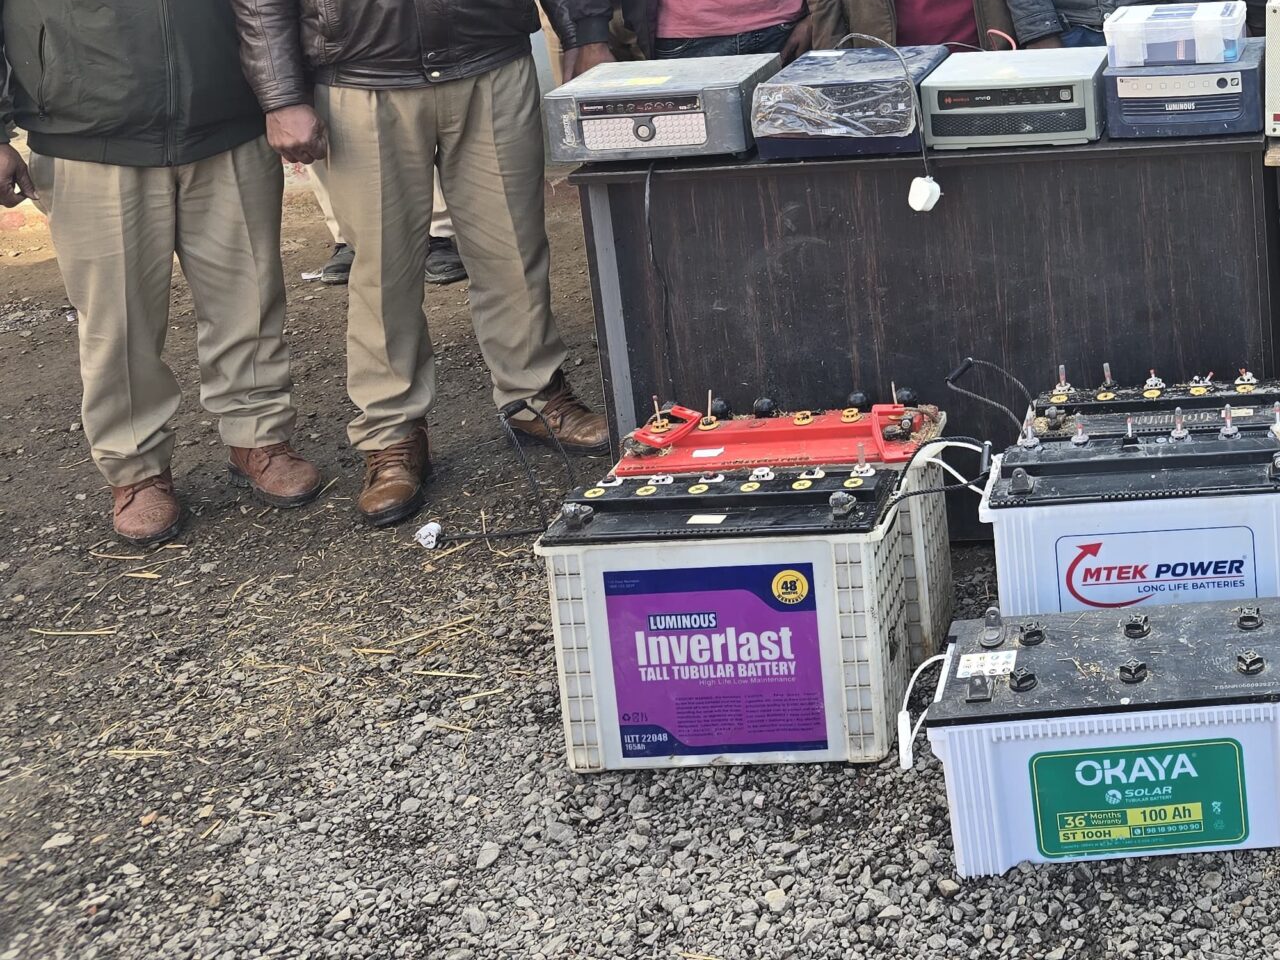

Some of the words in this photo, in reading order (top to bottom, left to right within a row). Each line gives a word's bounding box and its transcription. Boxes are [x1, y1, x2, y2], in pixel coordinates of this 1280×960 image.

[1165, 102, 1196, 111] LUMINOUS
[1082, 564, 1149, 583] MTEK
[1155, 559, 1245, 578] POWER
[1138, 583, 1166, 593] LONG
[1168, 582, 1189, 591] LIFE
[1192, 580, 1245, 590] BATTERIES
[649, 613, 717, 630] LUMINOUS
[635, 626, 795, 666] Inverlast
[639, 667, 670, 681] TALL
[671, 664, 735, 680] TUBULAR
[737, 661, 796, 677] BATTERY
[1075, 753, 1198, 786] OKAYA
[1124, 786, 1172, 798] SOLAR
[1089, 812, 1122, 820] Months
[1140, 807, 1168, 823] 100
[1171, 805, 1192, 820] Ah
[1091, 818, 1122, 826] Warranty
[1167, 824, 1177, 832] 90
[1178, 823, 1188, 831] 90
[1189, 822, 1200, 830] 90
[1062, 832, 1078, 841] ST
